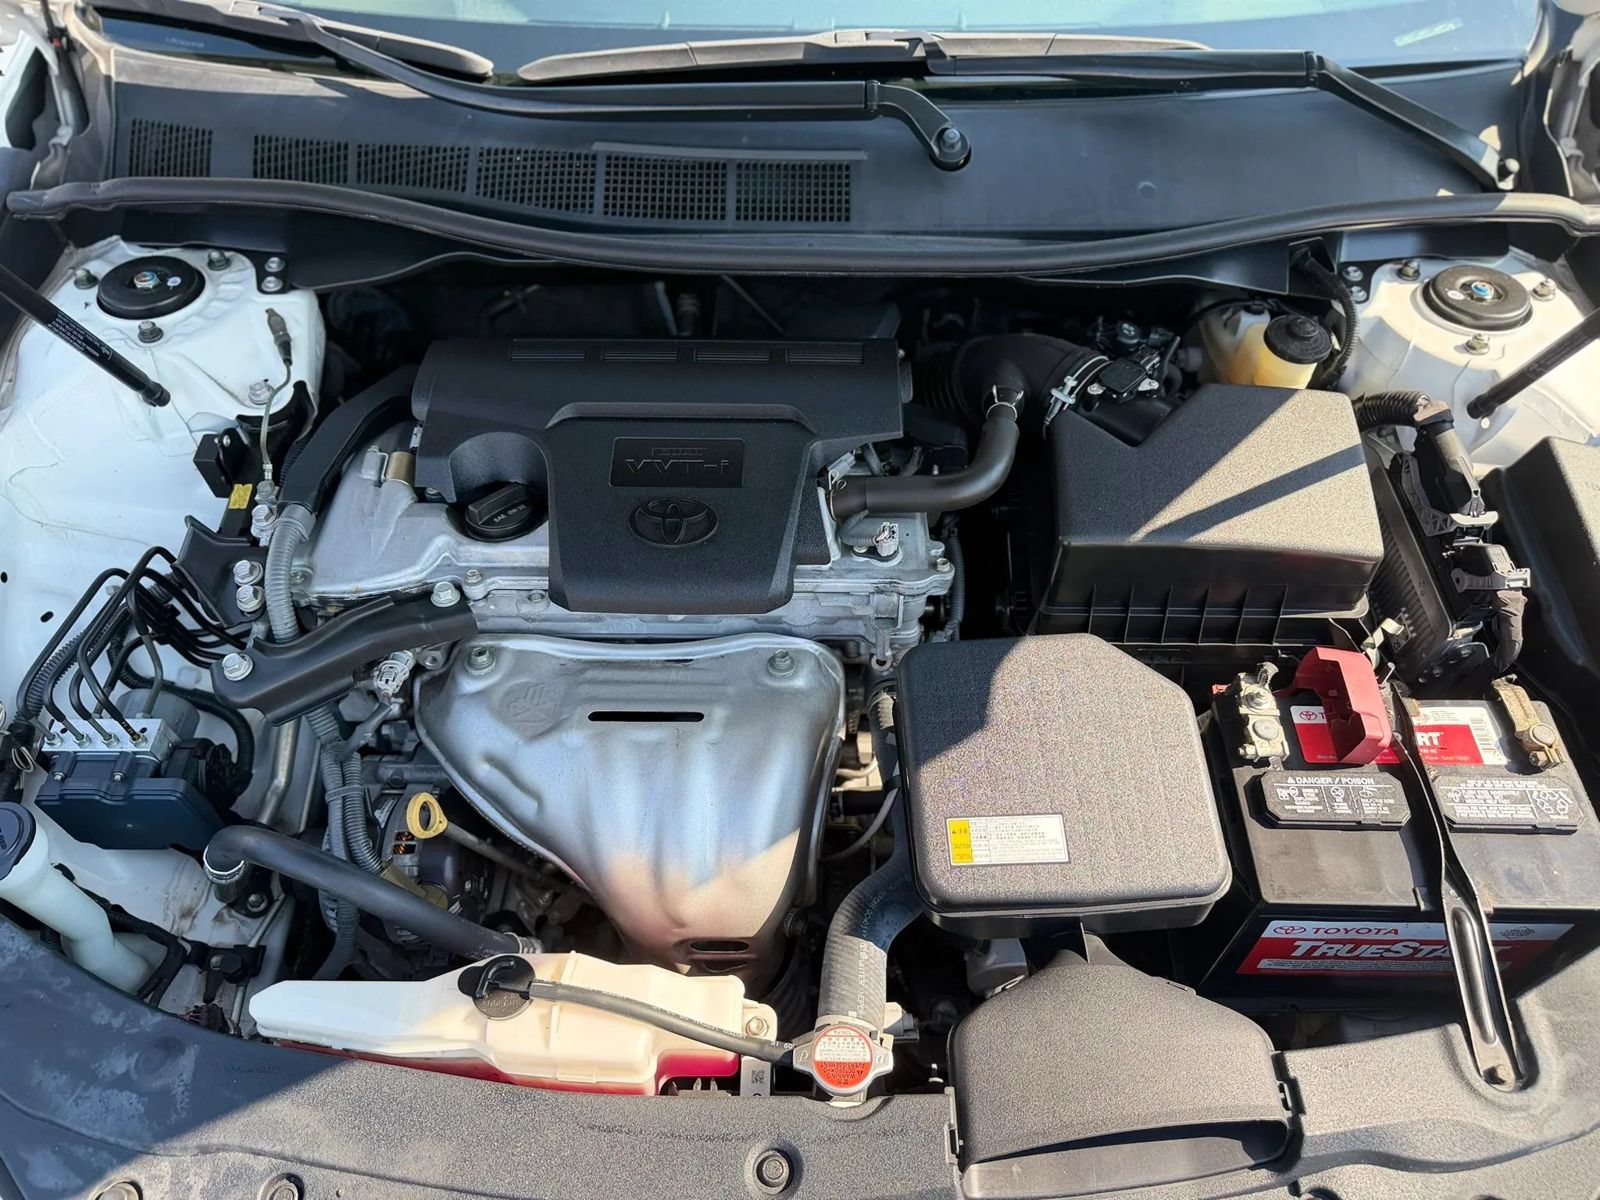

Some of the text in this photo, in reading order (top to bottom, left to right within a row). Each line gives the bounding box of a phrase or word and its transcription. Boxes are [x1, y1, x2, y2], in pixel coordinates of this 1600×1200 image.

[1295, 776, 1333, 785] DANGER
[1341, 776, 1375, 785] POISON
[1311, 926, 1400, 936] TOYOTA
